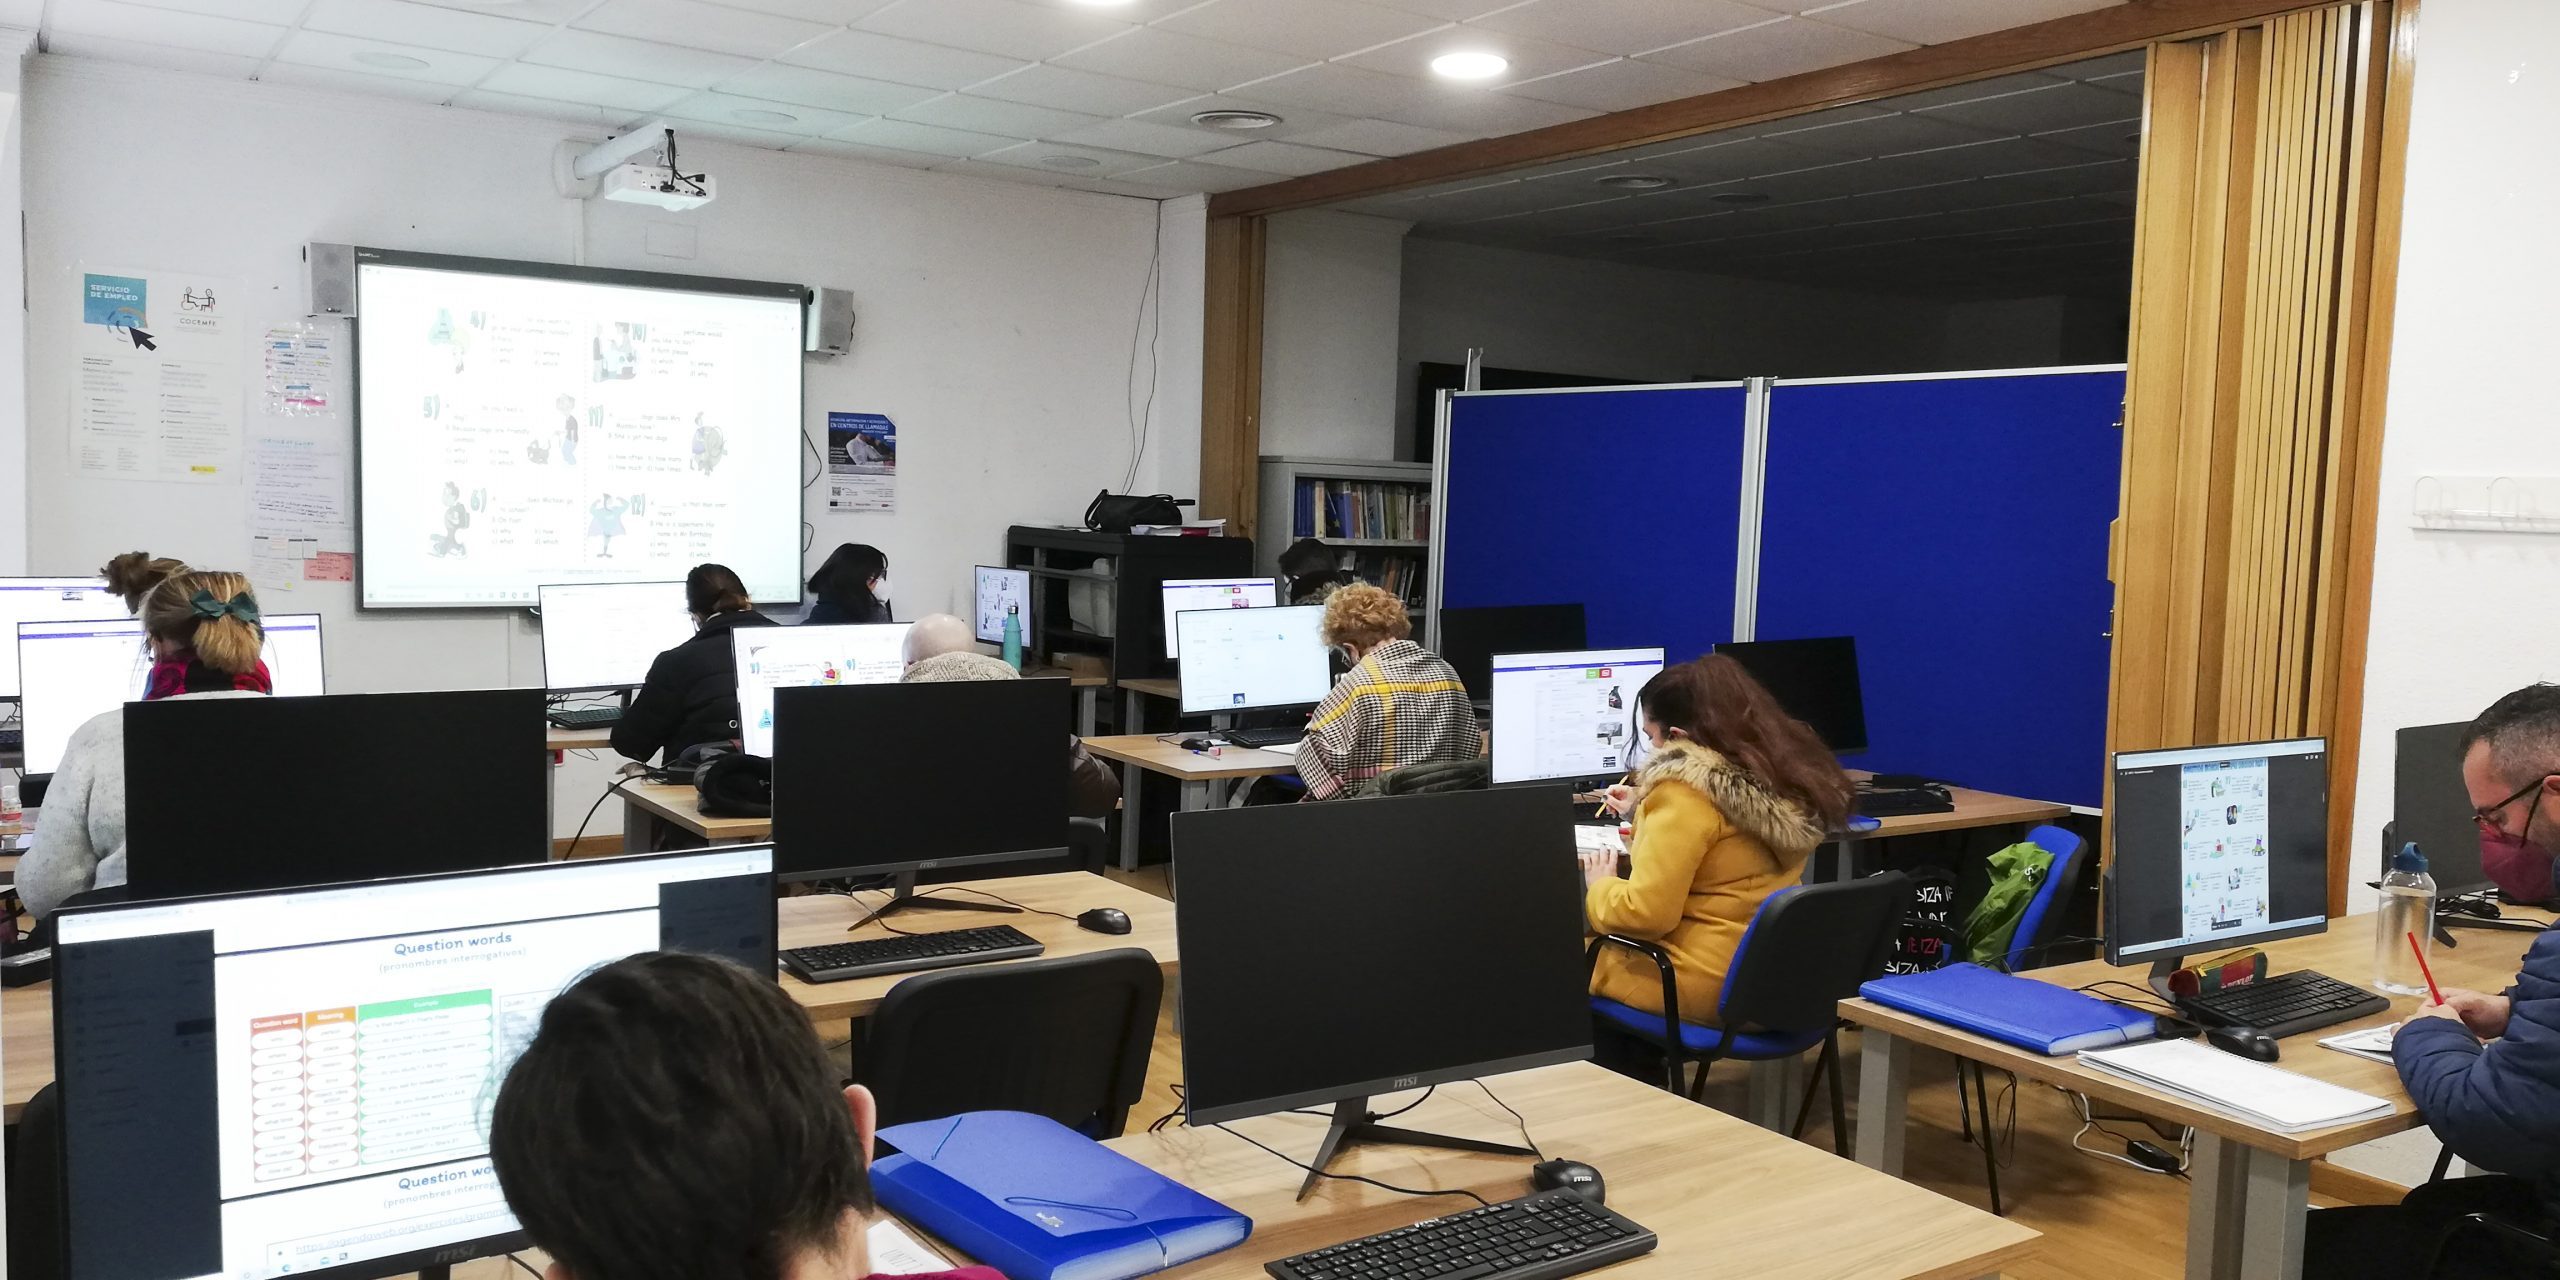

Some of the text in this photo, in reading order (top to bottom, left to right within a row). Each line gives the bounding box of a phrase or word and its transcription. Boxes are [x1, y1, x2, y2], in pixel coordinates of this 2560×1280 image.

[90, 284, 130, 293] SERVICIO
[104, 292, 138, 302] EMPLEO
[423, 394, 440, 421] 5)
[470, 487, 487, 513] 6)
[394, 932, 512, 956] Question words
[379, 947, 527, 975] (pronombres interrogativos)
[253, 1021, 282, 1029] Question
[1394, 1076, 1417, 1089] msi
[399, 1168, 467, 1190] Question
[1574, 1175, 1592, 1183] msi
[384, 1188, 451, 1208] (pronombres
[435, 1245, 477, 1264] msi
